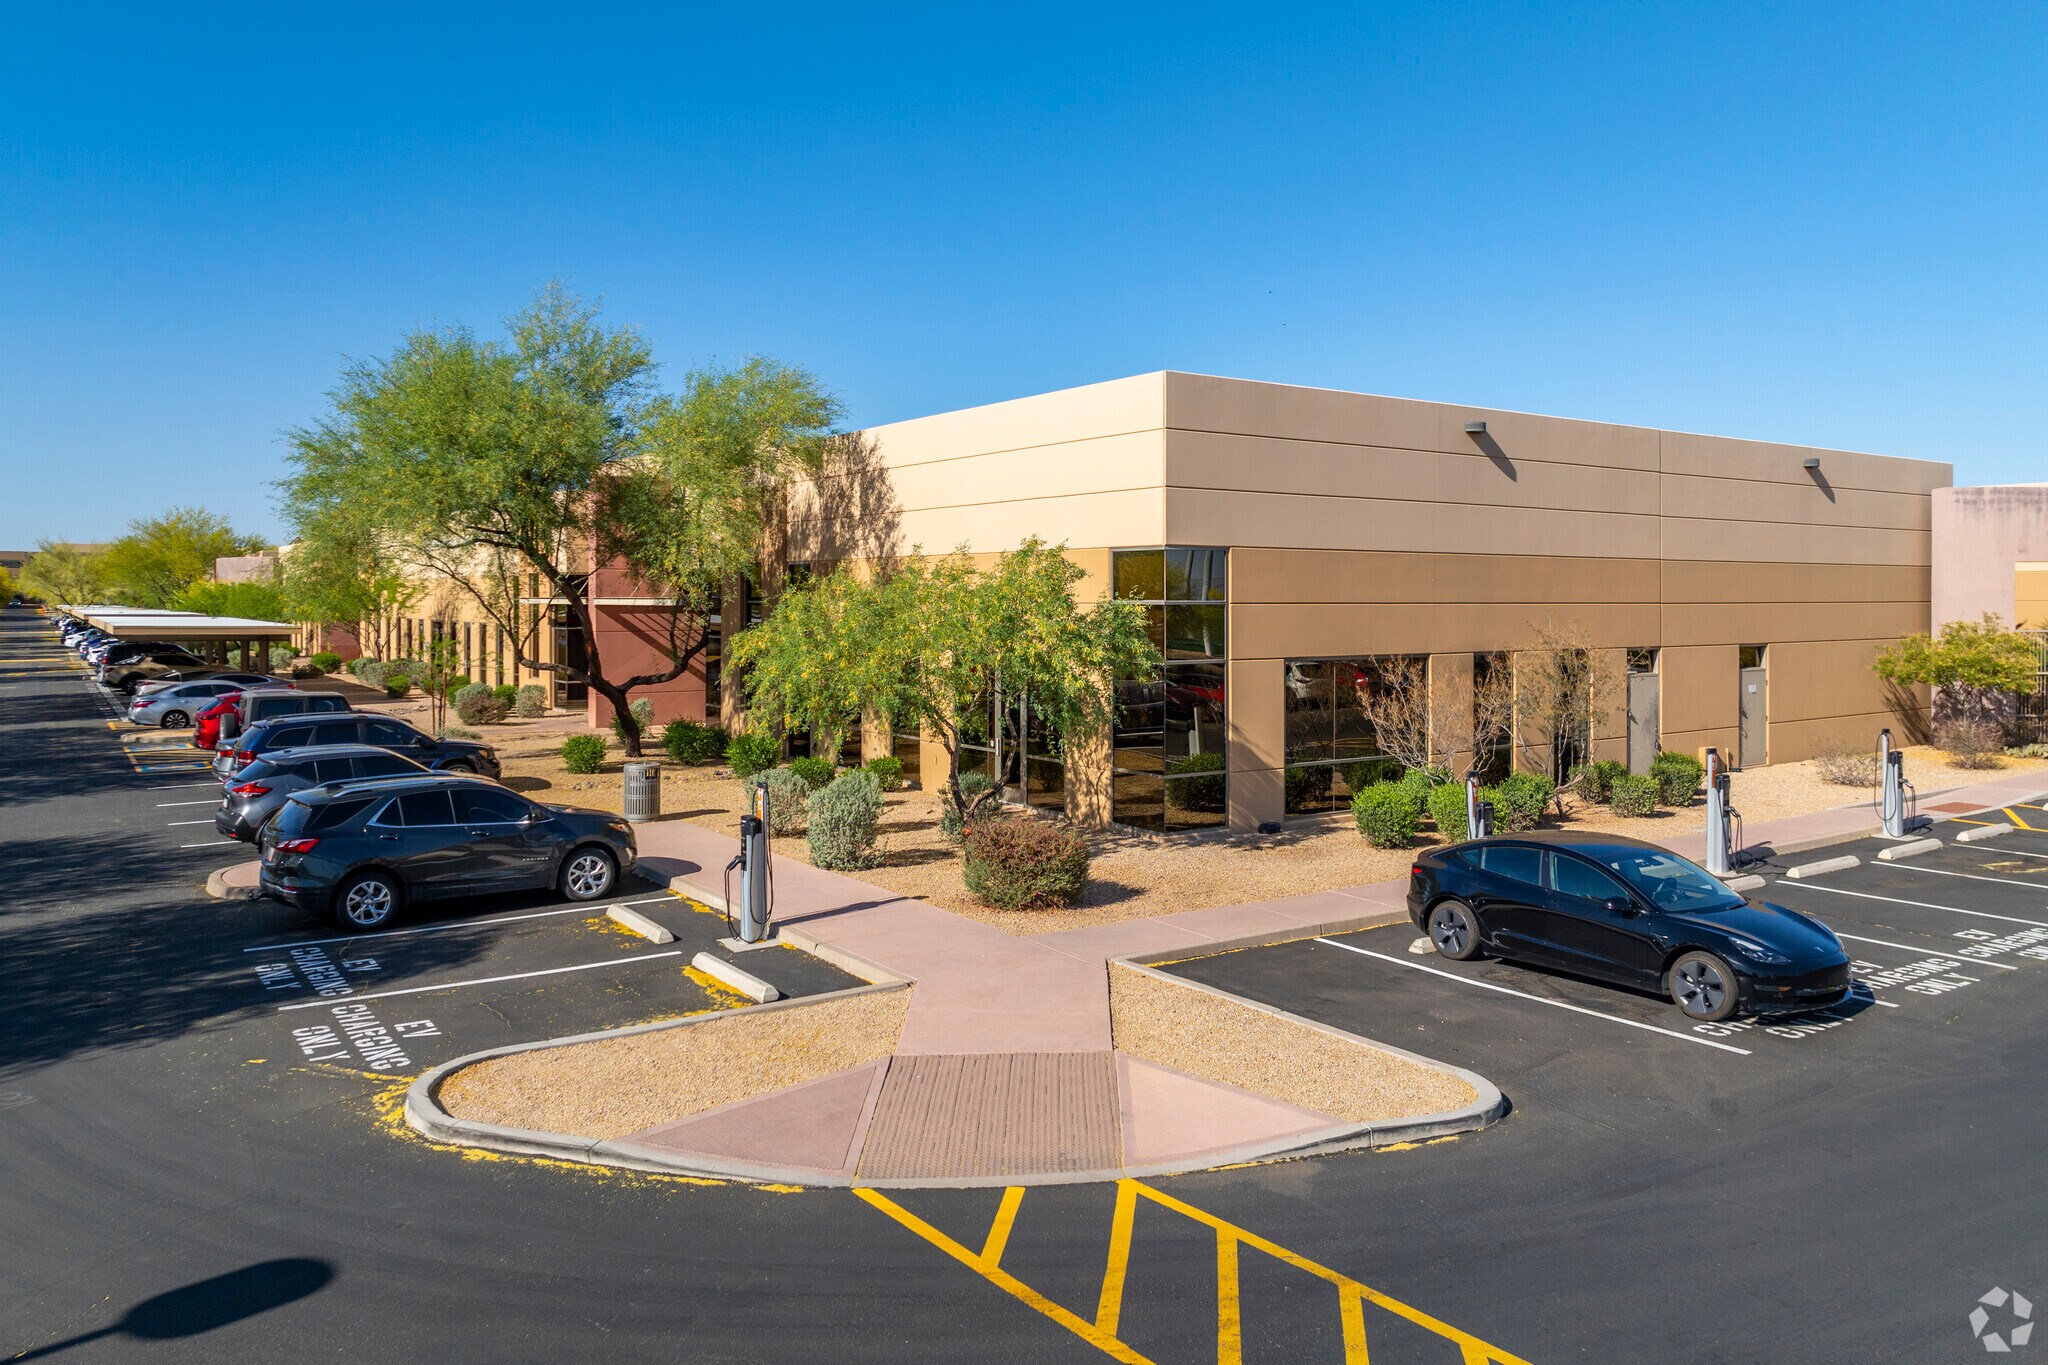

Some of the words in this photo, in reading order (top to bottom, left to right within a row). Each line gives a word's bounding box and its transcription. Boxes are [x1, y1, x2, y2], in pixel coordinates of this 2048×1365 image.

[1952, 928, 1997, 940] EV
[254, 963, 302, 990] ONLY
[289, 947, 354, 997] CHARGING
[342, 958, 382, 972] EV
[1904, 972, 1981, 996] ONLY
[331, 1004, 411, 1070] CHARGING
[393, 1019, 442, 1038] EV
[291, 1025, 351, 1062] ONLY
